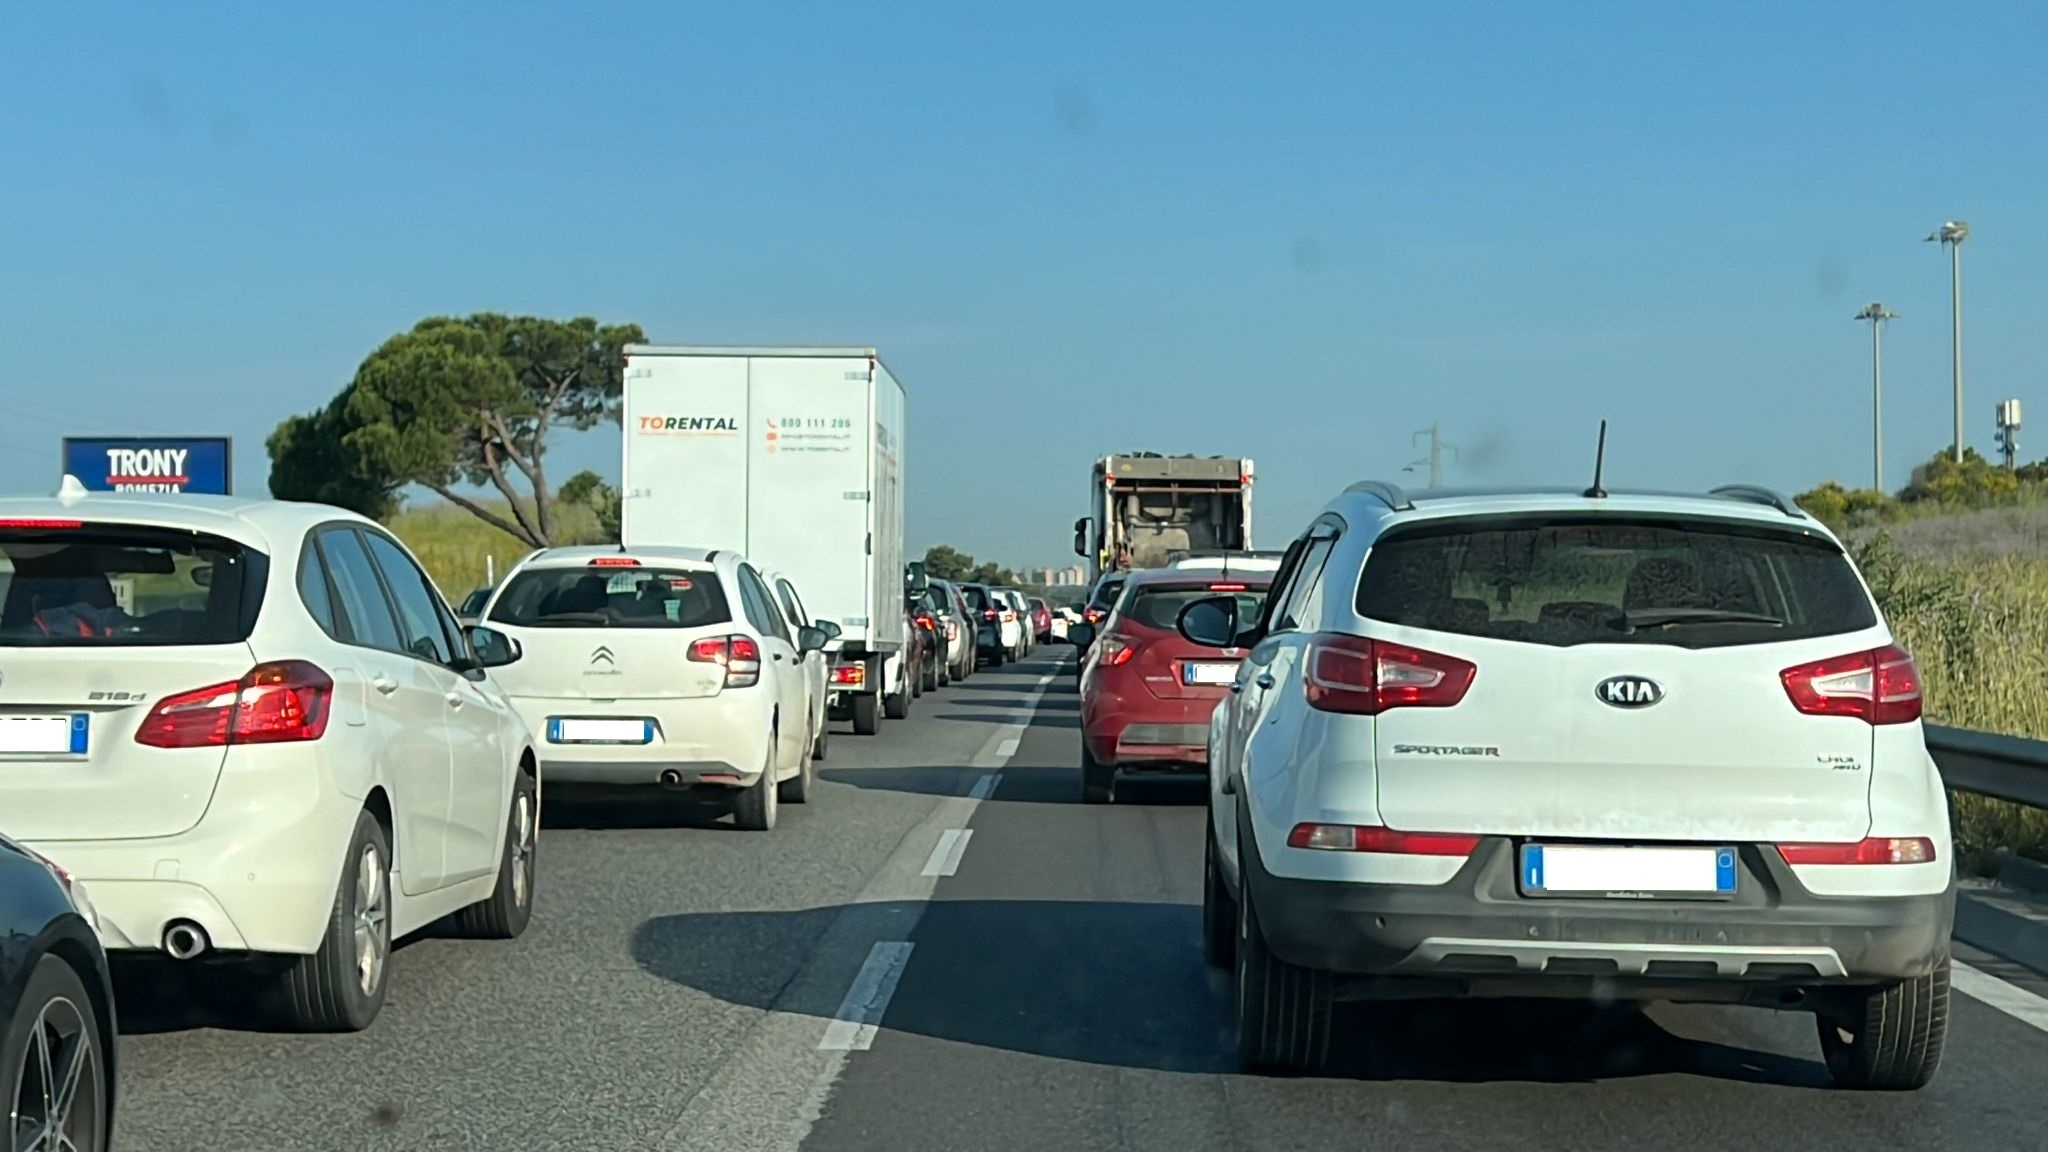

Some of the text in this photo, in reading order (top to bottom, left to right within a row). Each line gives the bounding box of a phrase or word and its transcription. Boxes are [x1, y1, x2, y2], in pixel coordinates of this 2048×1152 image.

[639, 416, 738, 430] TORENTAL
[106, 449, 187, 477] TRONY
[1607, 681, 1654, 702] KIA
